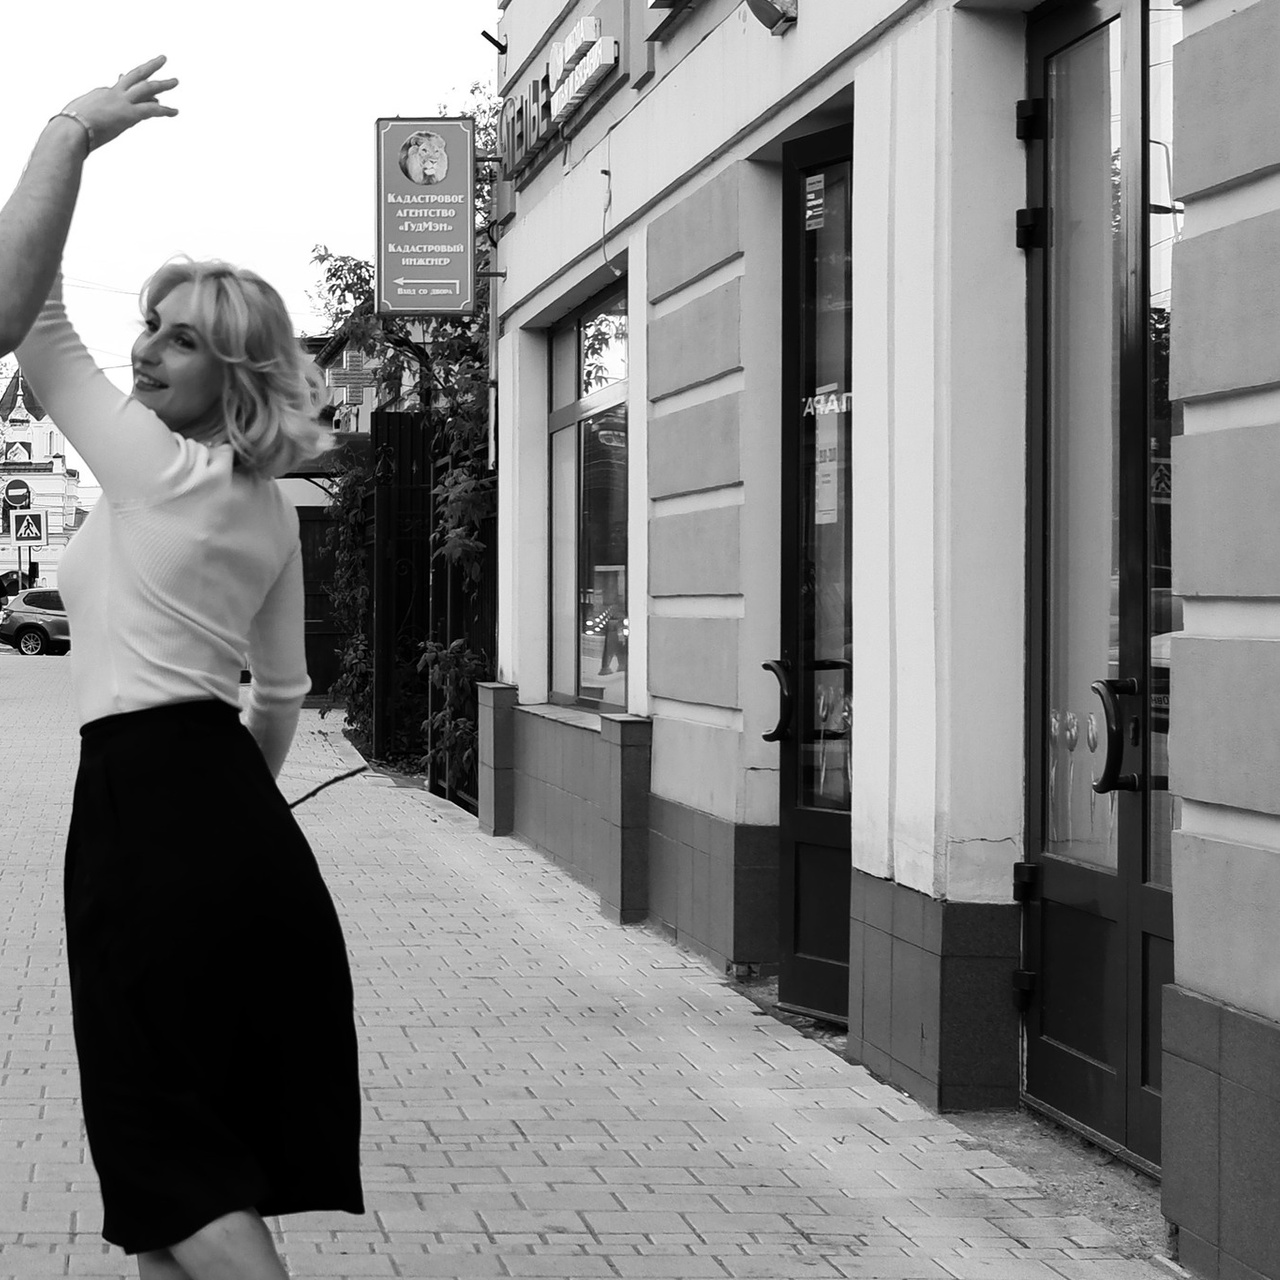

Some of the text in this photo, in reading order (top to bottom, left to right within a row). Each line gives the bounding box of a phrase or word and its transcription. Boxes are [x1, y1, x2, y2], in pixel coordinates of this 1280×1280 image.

[387, 193, 465, 204] КАДАСТРОВОЕ
[396, 208, 456, 218] АГЕНТСТВО
[388, 243, 464, 253] КАДАСТРОВЫЙ
[401, 257, 451, 266] ИНЖЕНЕР
